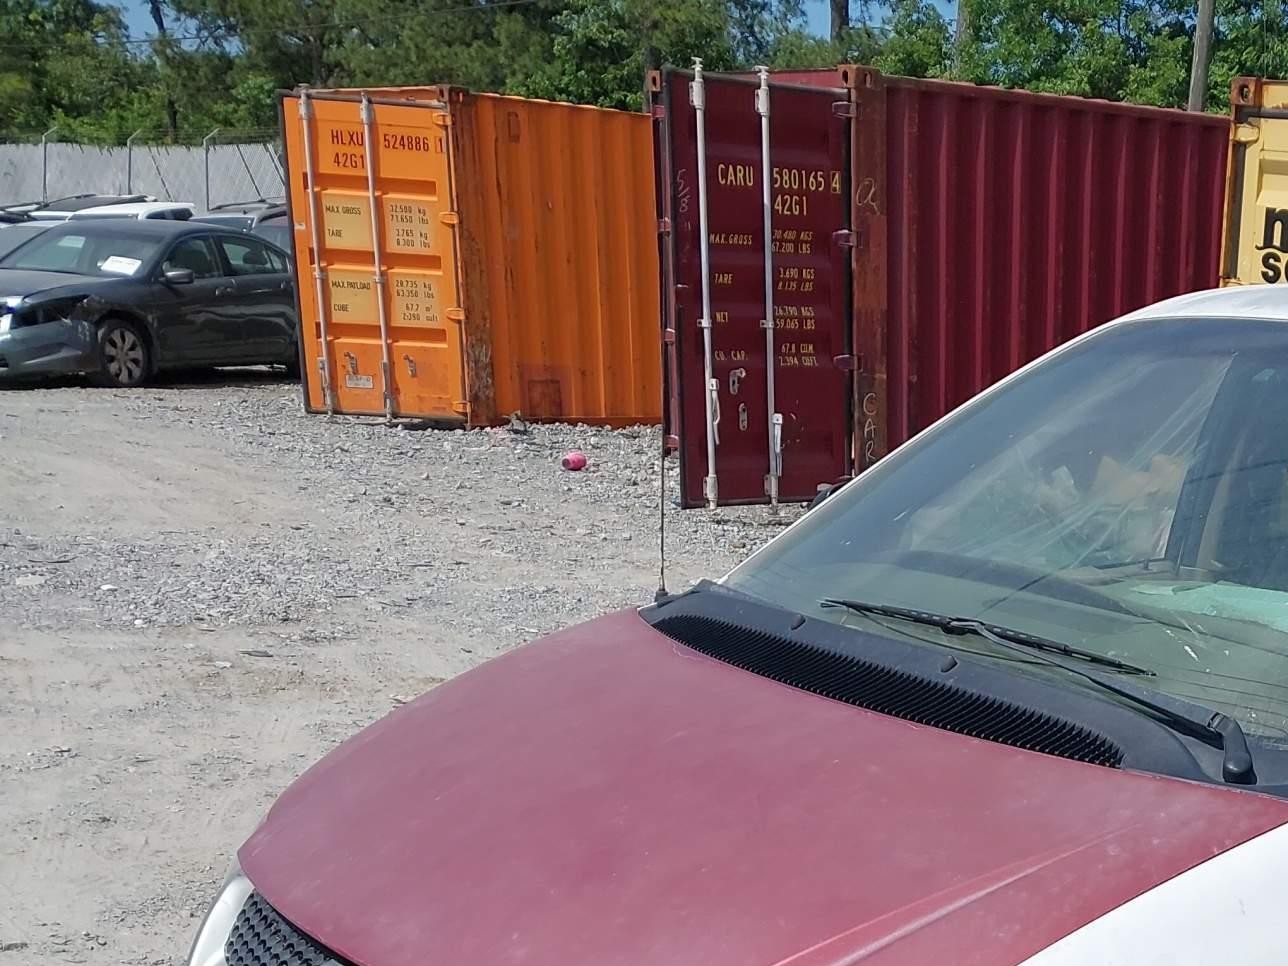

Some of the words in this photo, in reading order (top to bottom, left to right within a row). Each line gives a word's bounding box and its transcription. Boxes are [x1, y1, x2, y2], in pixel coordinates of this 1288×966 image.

[330, 128, 364, 147] HLXU
[383, 133, 430, 153] 524886
[333, 151, 365, 169] 42G1
[717, 163, 755, 187] CARU
[772, 167, 826, 191] 580165
[831, 171, 842, 194] 4
[774, 193, 808, 217] 42G1
[800, 231, 814, 242] KGS
[798, 243, 812, 255] LBS
[714, 272, 733, 284] TARE
[802, 268, 816, 280] KGS
[800, 281, 815, 292] LBS
[333, 303, 350, 313] CUBE
[801, 306, 815, 317] KGS
[715, 311, 729, 323] NET
[803, 319, 816, 330] LBS
